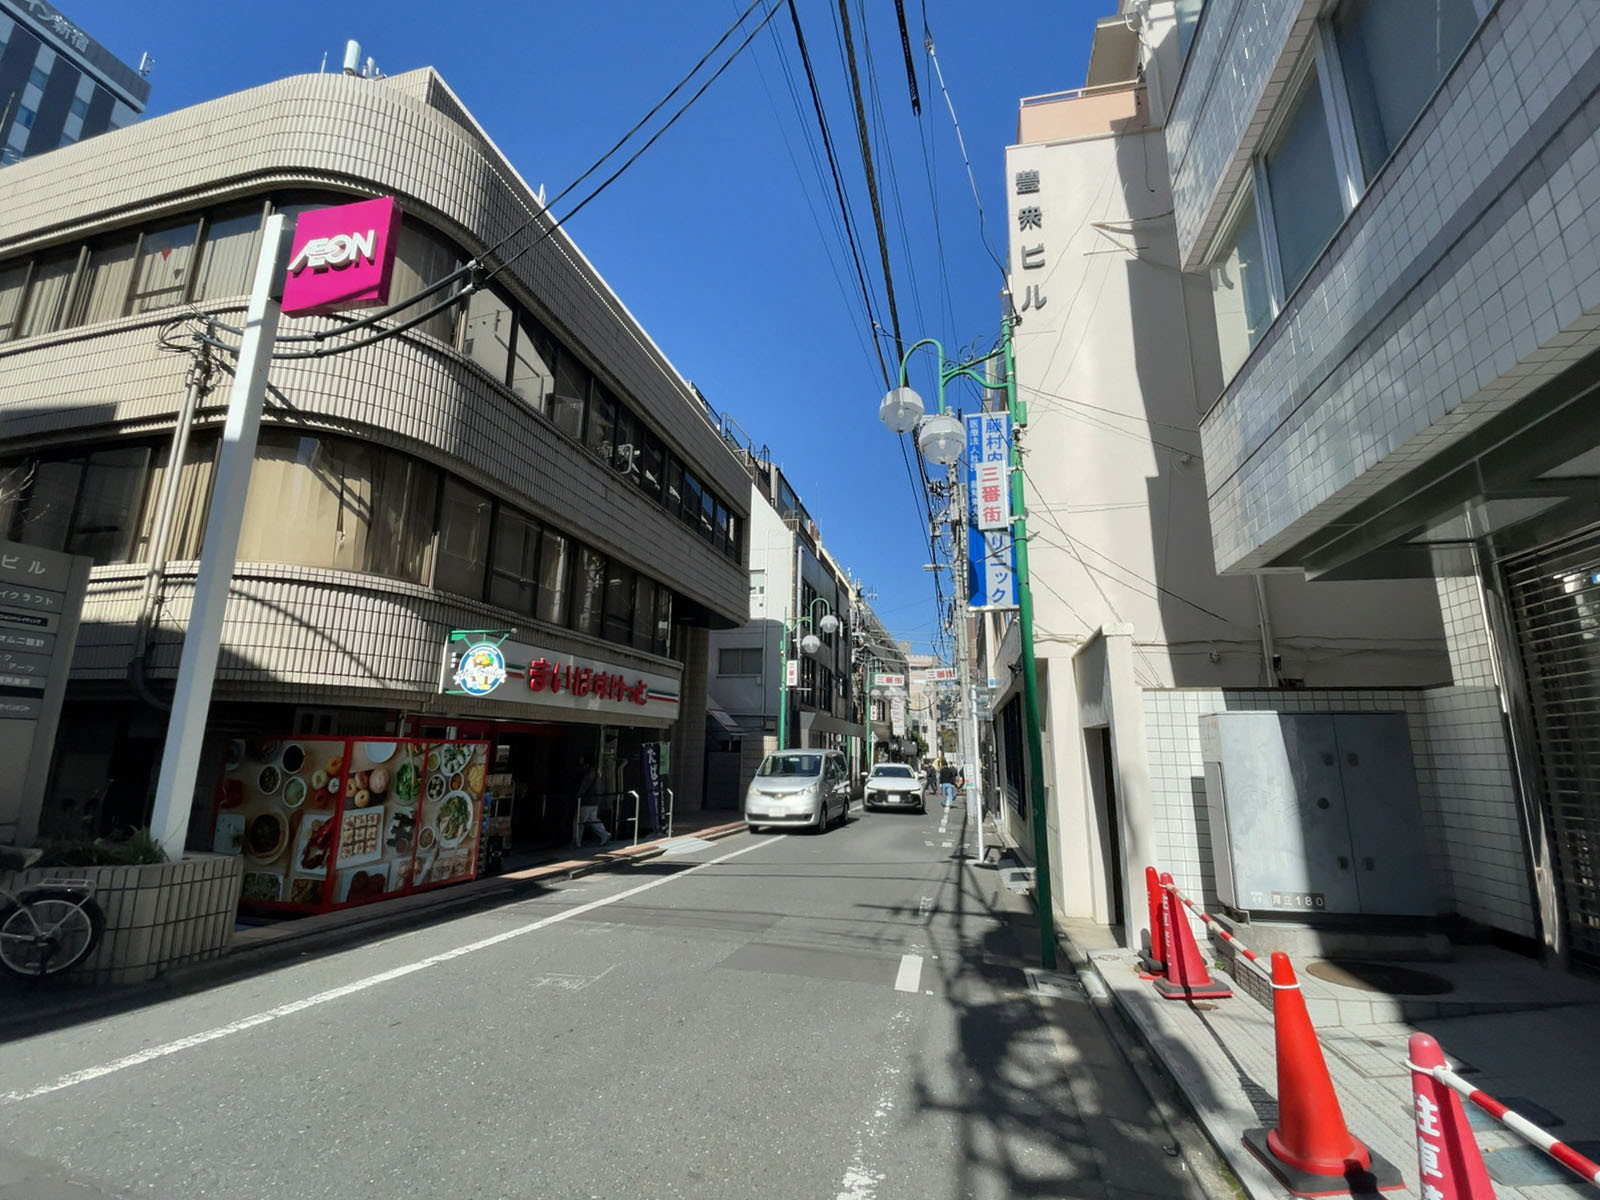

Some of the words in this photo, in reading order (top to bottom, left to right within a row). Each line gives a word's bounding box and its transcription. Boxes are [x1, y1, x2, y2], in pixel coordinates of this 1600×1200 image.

[287, 229, 375, 270] AEON
[982, 466, 1001, 522] 三番街
[530, 658, 647, 705] まいばすけっと
[877, 676, 903, 684] 三番街
